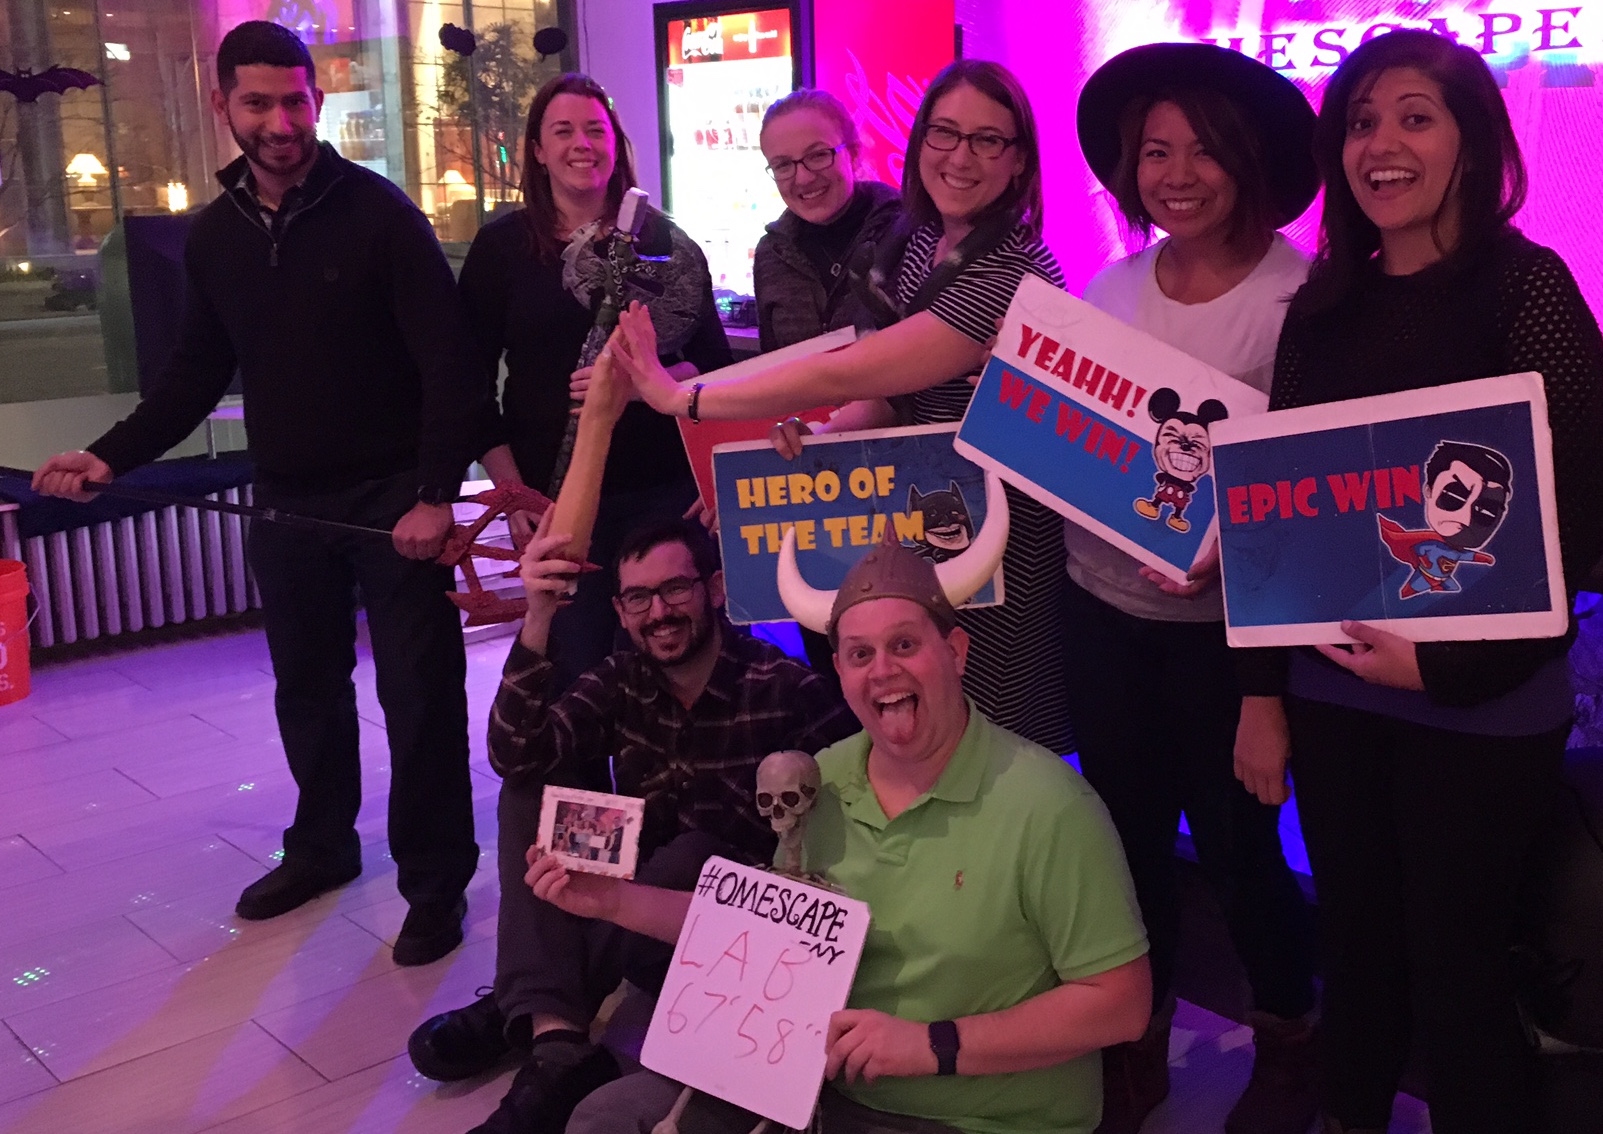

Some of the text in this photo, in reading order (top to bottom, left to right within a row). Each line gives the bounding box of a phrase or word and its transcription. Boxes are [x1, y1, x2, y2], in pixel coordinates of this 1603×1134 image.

[1017, 323, 1147, 418] YEAHH!
[999, 369, 1141, 474] WE WIN!
[736, 465, 895, 509] HERO OF
[1227, 465, 1421, 524] EPIC WIN
[740, 510, 925, 555] THE TEAM
[698, 865, 848, 942] #OMESCAPE
